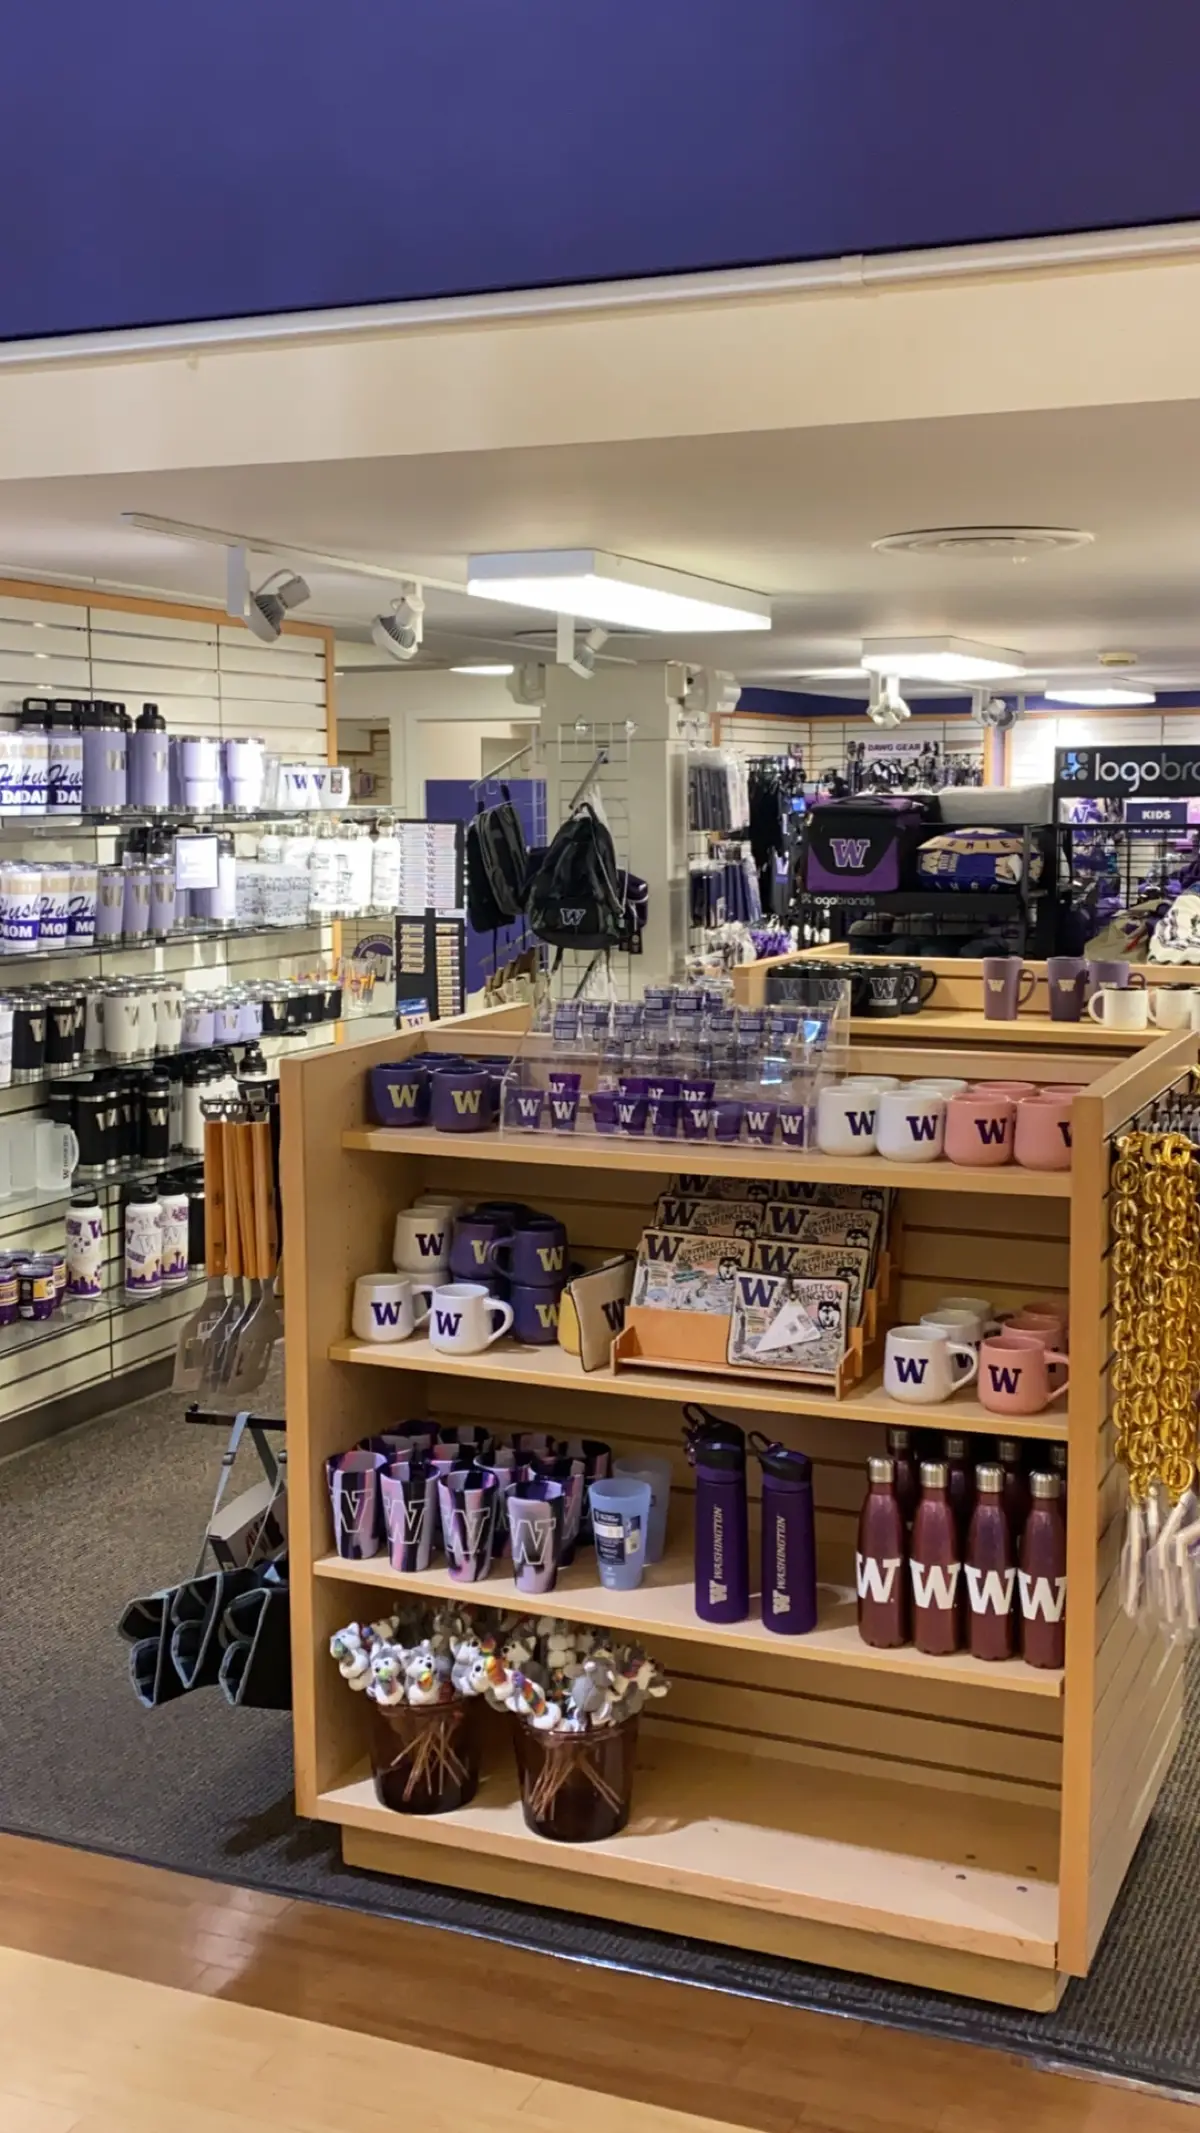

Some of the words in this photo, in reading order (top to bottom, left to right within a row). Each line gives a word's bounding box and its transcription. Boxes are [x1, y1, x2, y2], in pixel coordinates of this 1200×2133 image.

[868, 743, 894, 751] DAWG
[896, 743, 921, 751] GEAR
[1142, 810, 1172, 820] KIDS
[829, 838, 871, 868] W
[812, 895, 876, 908] ogobrands
[560, 908, 586, 925] W
[869, 977, 897, 999] W
[987, 979, 1006, 992] W
[1058, 979, 1077, 992] W
[388, 1084, 419, 1108] W
[451, 1090, 482, 1114] W
[518, 1099, 540, 1117] W
[553, 1101, 575, 1120] W
[747, 1112, 769, 1130] W
[844, 1110, 876, 1136] W
[781, 1115, 803, 1134] W
[906, 1115, 938, 1141] W
[974, 1118, 1008, 1144] W
[662, 1201, 697, 1227] W
[769, 1206, 809, 1236] W
[804, 1219, 872, 1236] WASHINGTON
[415, 1233, 444, 1256] W
[645, 1234, 684, 1262] W
[678, 1246, 745, 1263] WASHINGTON
[537, 1246, 564, 1272] W
[758, 1243, 800, 1273] W
[792, 1257, 863, 1273] WASHINGTON
[738, 1277, 778, 1308] W
[371, 1301, 402, 1326] W
[435, 1310, 463, 1336] W
[535, 1304, 560, 1328] W
[602, 1298, 627, 1331] W
[894, 1356, 929, 1384] W
[988, 1364, 1022, 1394] W
[383, 1499, 427, 1544] W
[441, 1507, 490, 1555] W
[508, 1519, 556, 1565] W
[713, 1504, 723, 1579] WASHINGTON
[776, 1513, 786, 1589] WASHINGTON
[856, 1551, 901, 1603] W
[909, 1557, 961, 1610] W
[964, 1563, 1017, 1616] W
[709, 1580, 727, 1605] W
[772, 1589, 790, 1615] W
[1017, 1568, 1067, 1623] W
